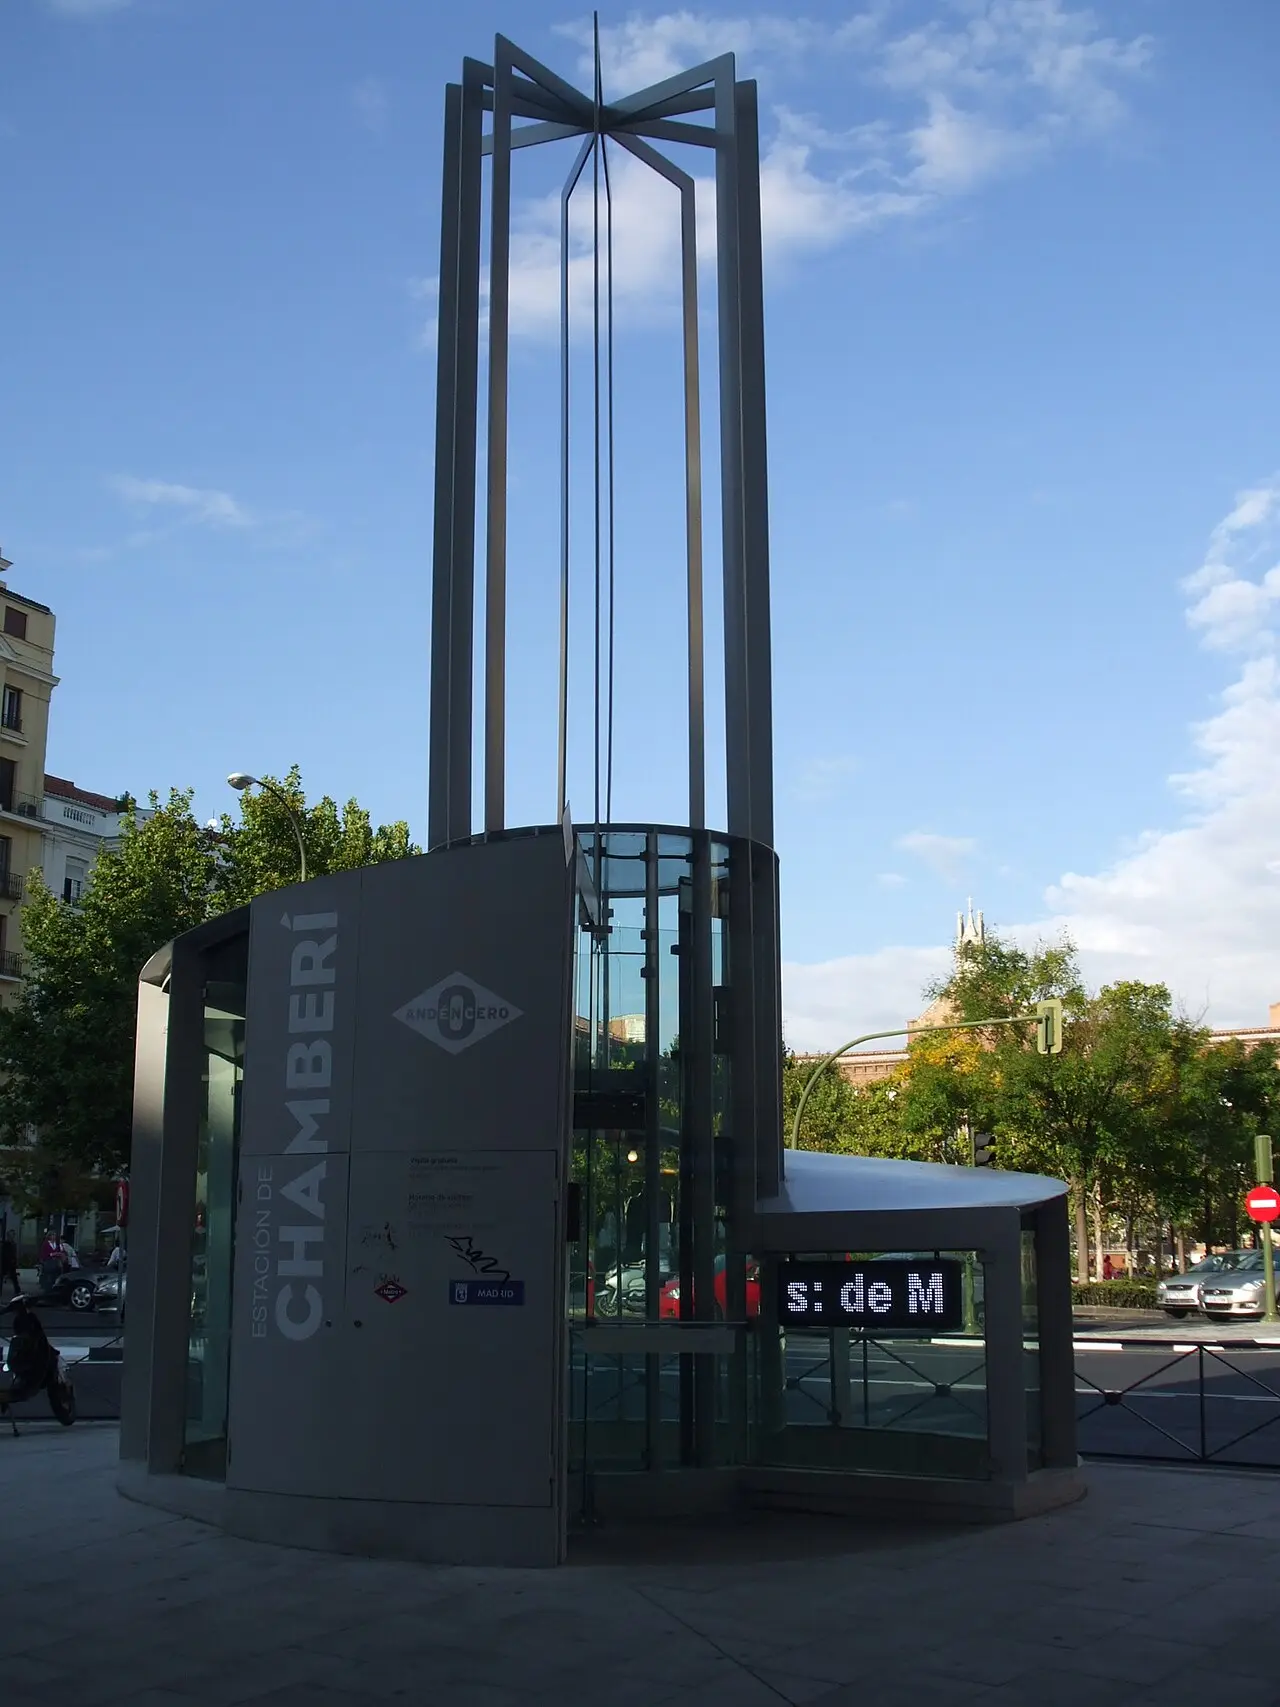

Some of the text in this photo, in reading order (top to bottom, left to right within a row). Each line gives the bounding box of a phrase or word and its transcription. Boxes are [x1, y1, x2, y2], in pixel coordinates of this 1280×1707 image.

[274, 910, 339, 1342] CHAMBERÍ
[251, 1164, 274, 1339] ESTACIÓN DE
[787, 1271, 945, 1314] s: de M
